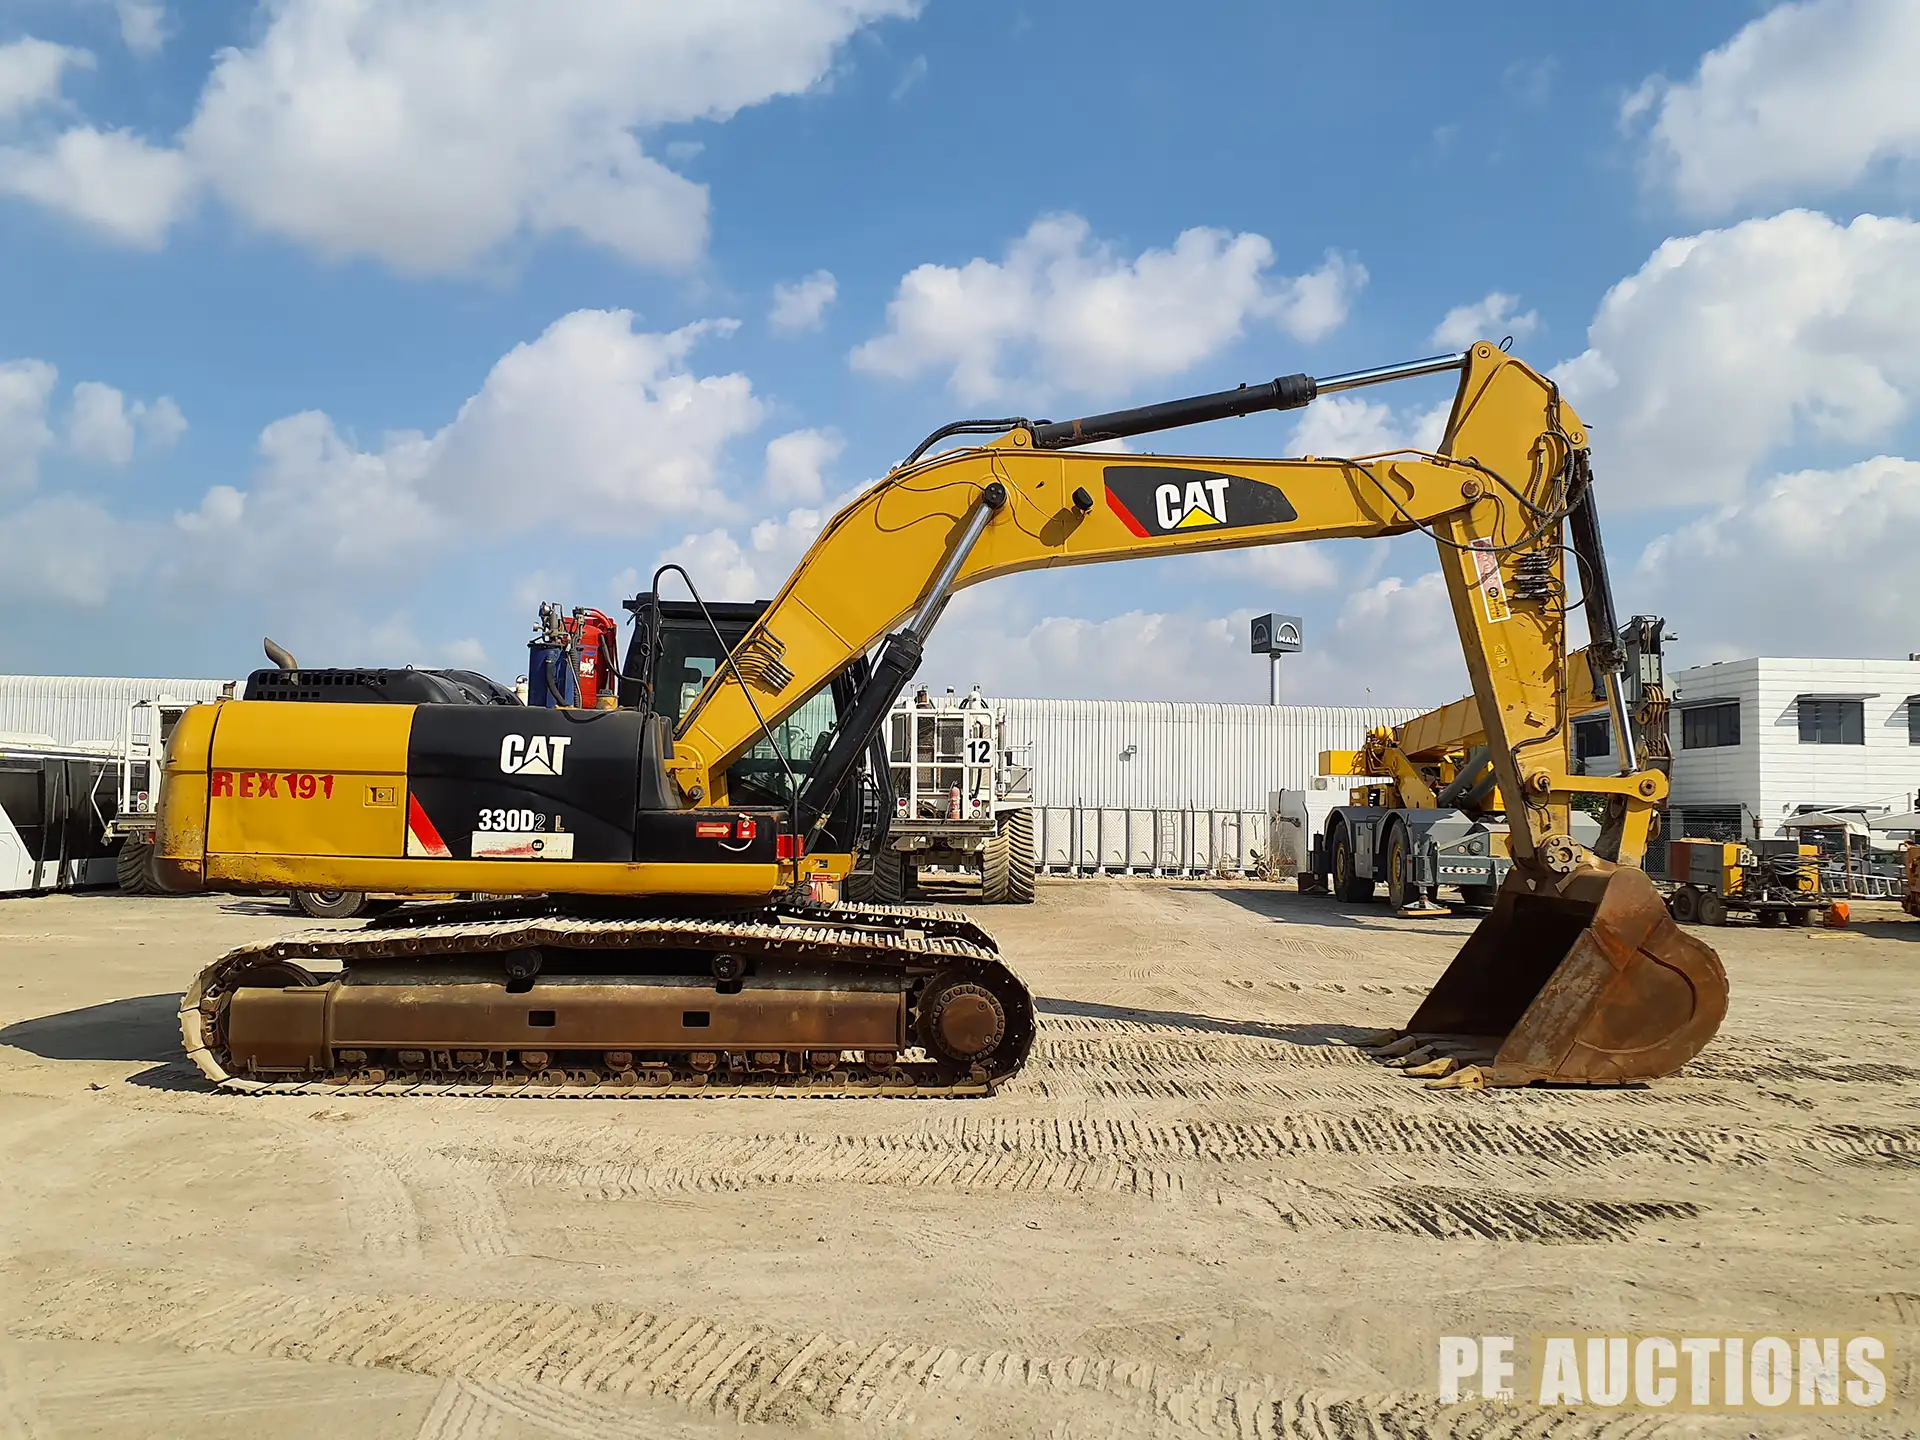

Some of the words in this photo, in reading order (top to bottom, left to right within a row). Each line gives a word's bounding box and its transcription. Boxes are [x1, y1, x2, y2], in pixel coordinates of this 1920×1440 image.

[1155, 477, 1230, 530] CAT
[1279, 635, 1298, 645] MAN
[500, 733, 572, 776] CAT
[967, 740, 990, 763] 12
[212, 771, 278, 798] REX
[283, 773, 334, 800] 191
